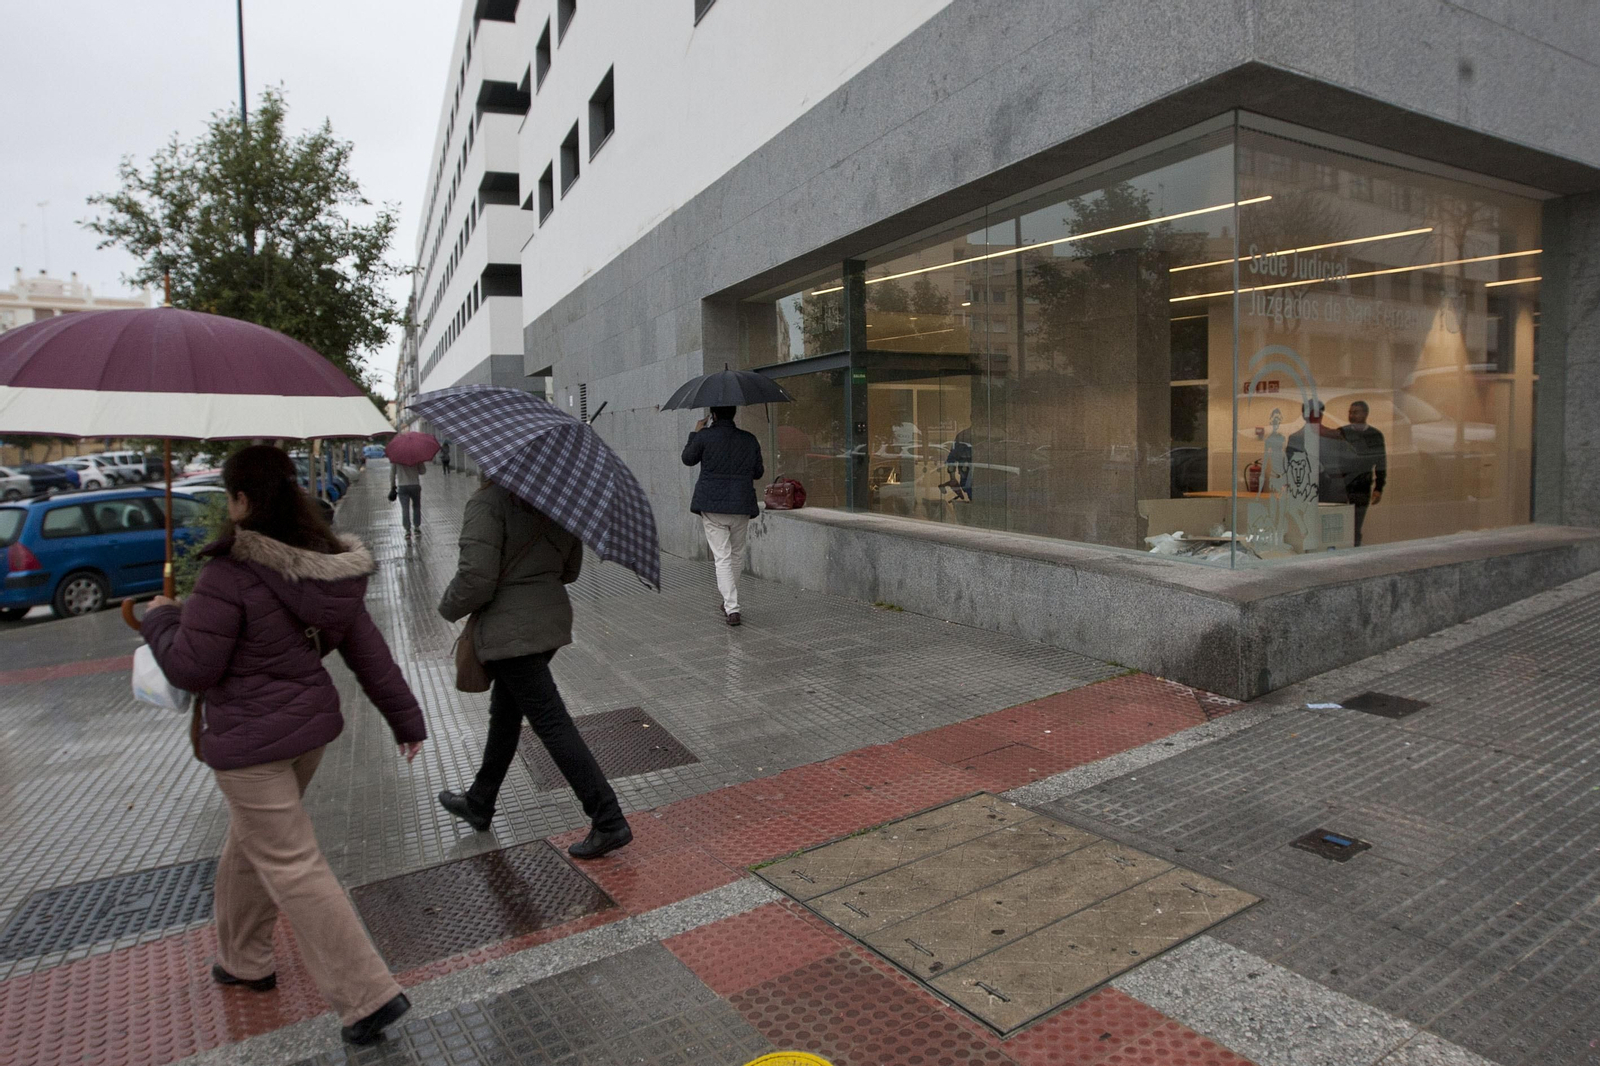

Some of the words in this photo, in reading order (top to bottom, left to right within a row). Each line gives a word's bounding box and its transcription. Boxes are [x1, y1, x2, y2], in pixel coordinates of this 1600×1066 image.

[1249, 244, 1288, 277] Sede
[1291, 250, 1348, 284] Judicial
[1249, 288, 1319, 324] Juzgados
[1325, 296, 1341, 322] de
[1346, 297, 1373, 324] San
[1376, 300, 1436, 330] Fernan
